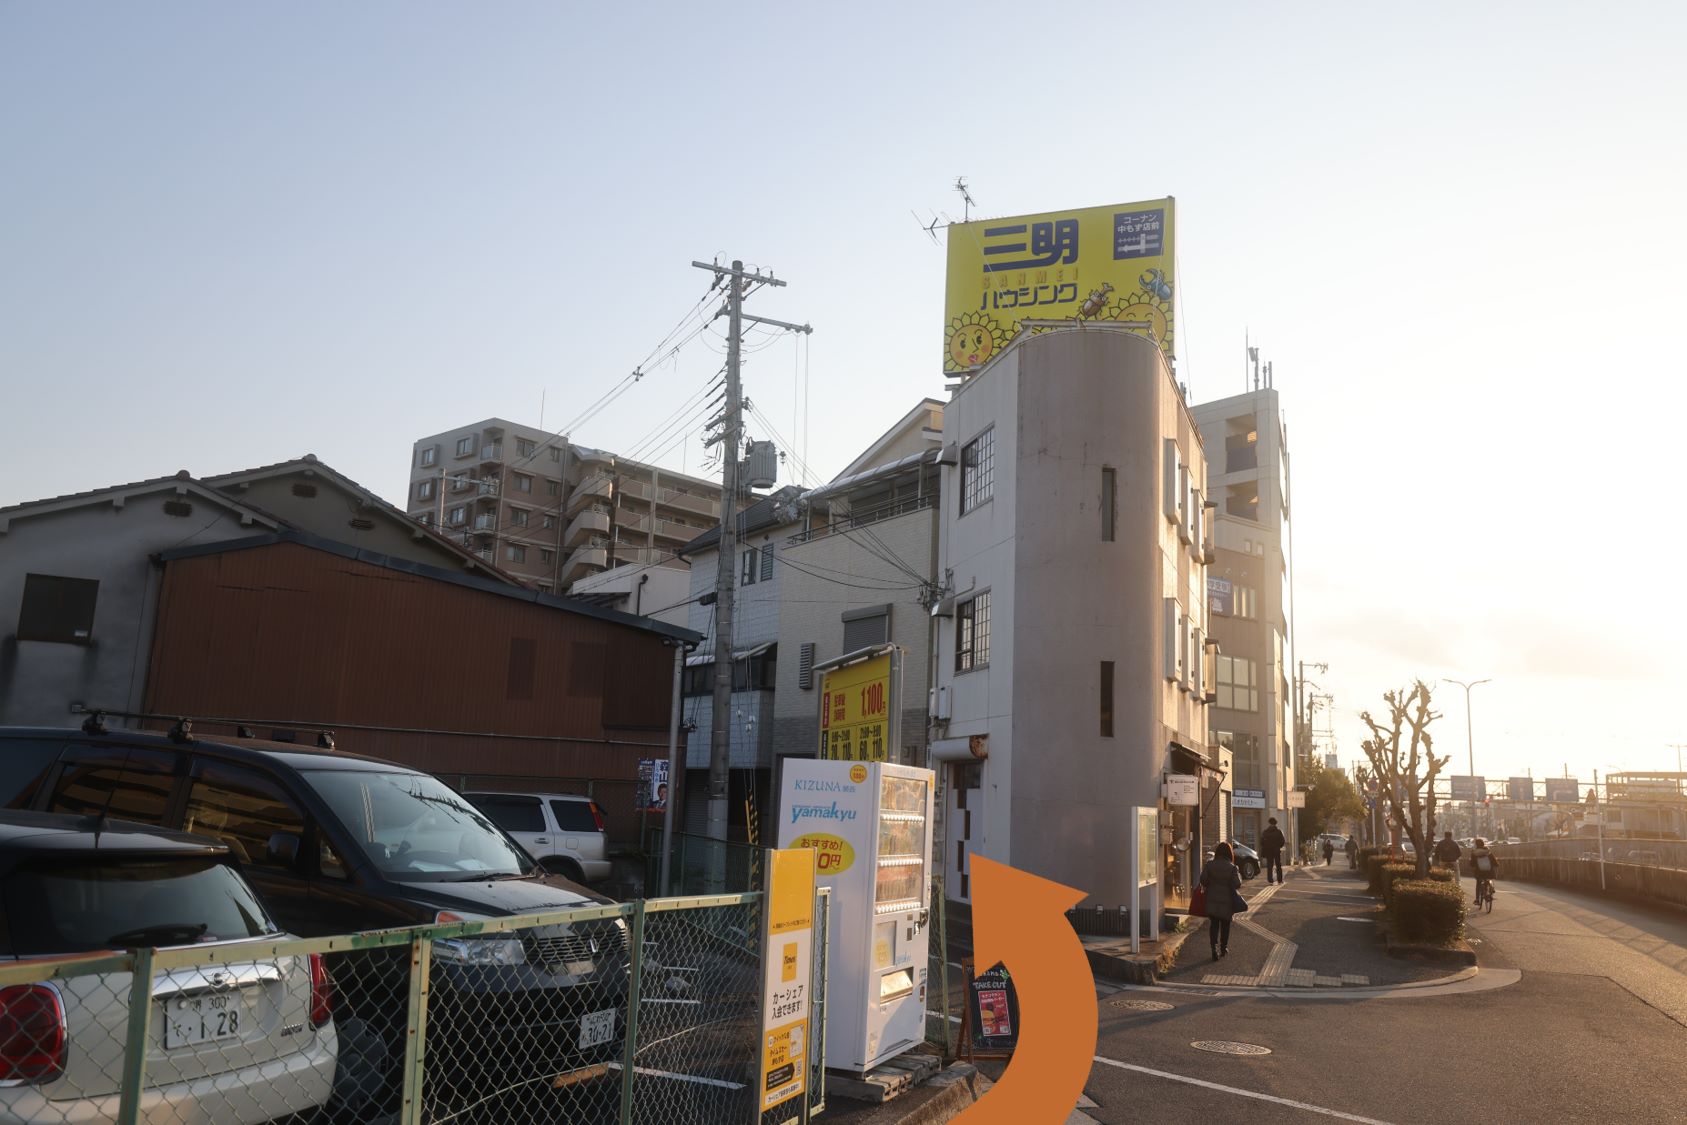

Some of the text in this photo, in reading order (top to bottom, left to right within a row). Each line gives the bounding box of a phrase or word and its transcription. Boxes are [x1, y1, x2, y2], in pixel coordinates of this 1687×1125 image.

[1123, 214, 1157, 224] コーナン
[1117, 221, 1160, 234] 中もず店前
[983, 219, 1079, 272] 三明
[794, 779, 841, 792] KIZUNA
[791, 801, 857, 824] yamakyu
[772, 985, 804, 1005] カーシェア
